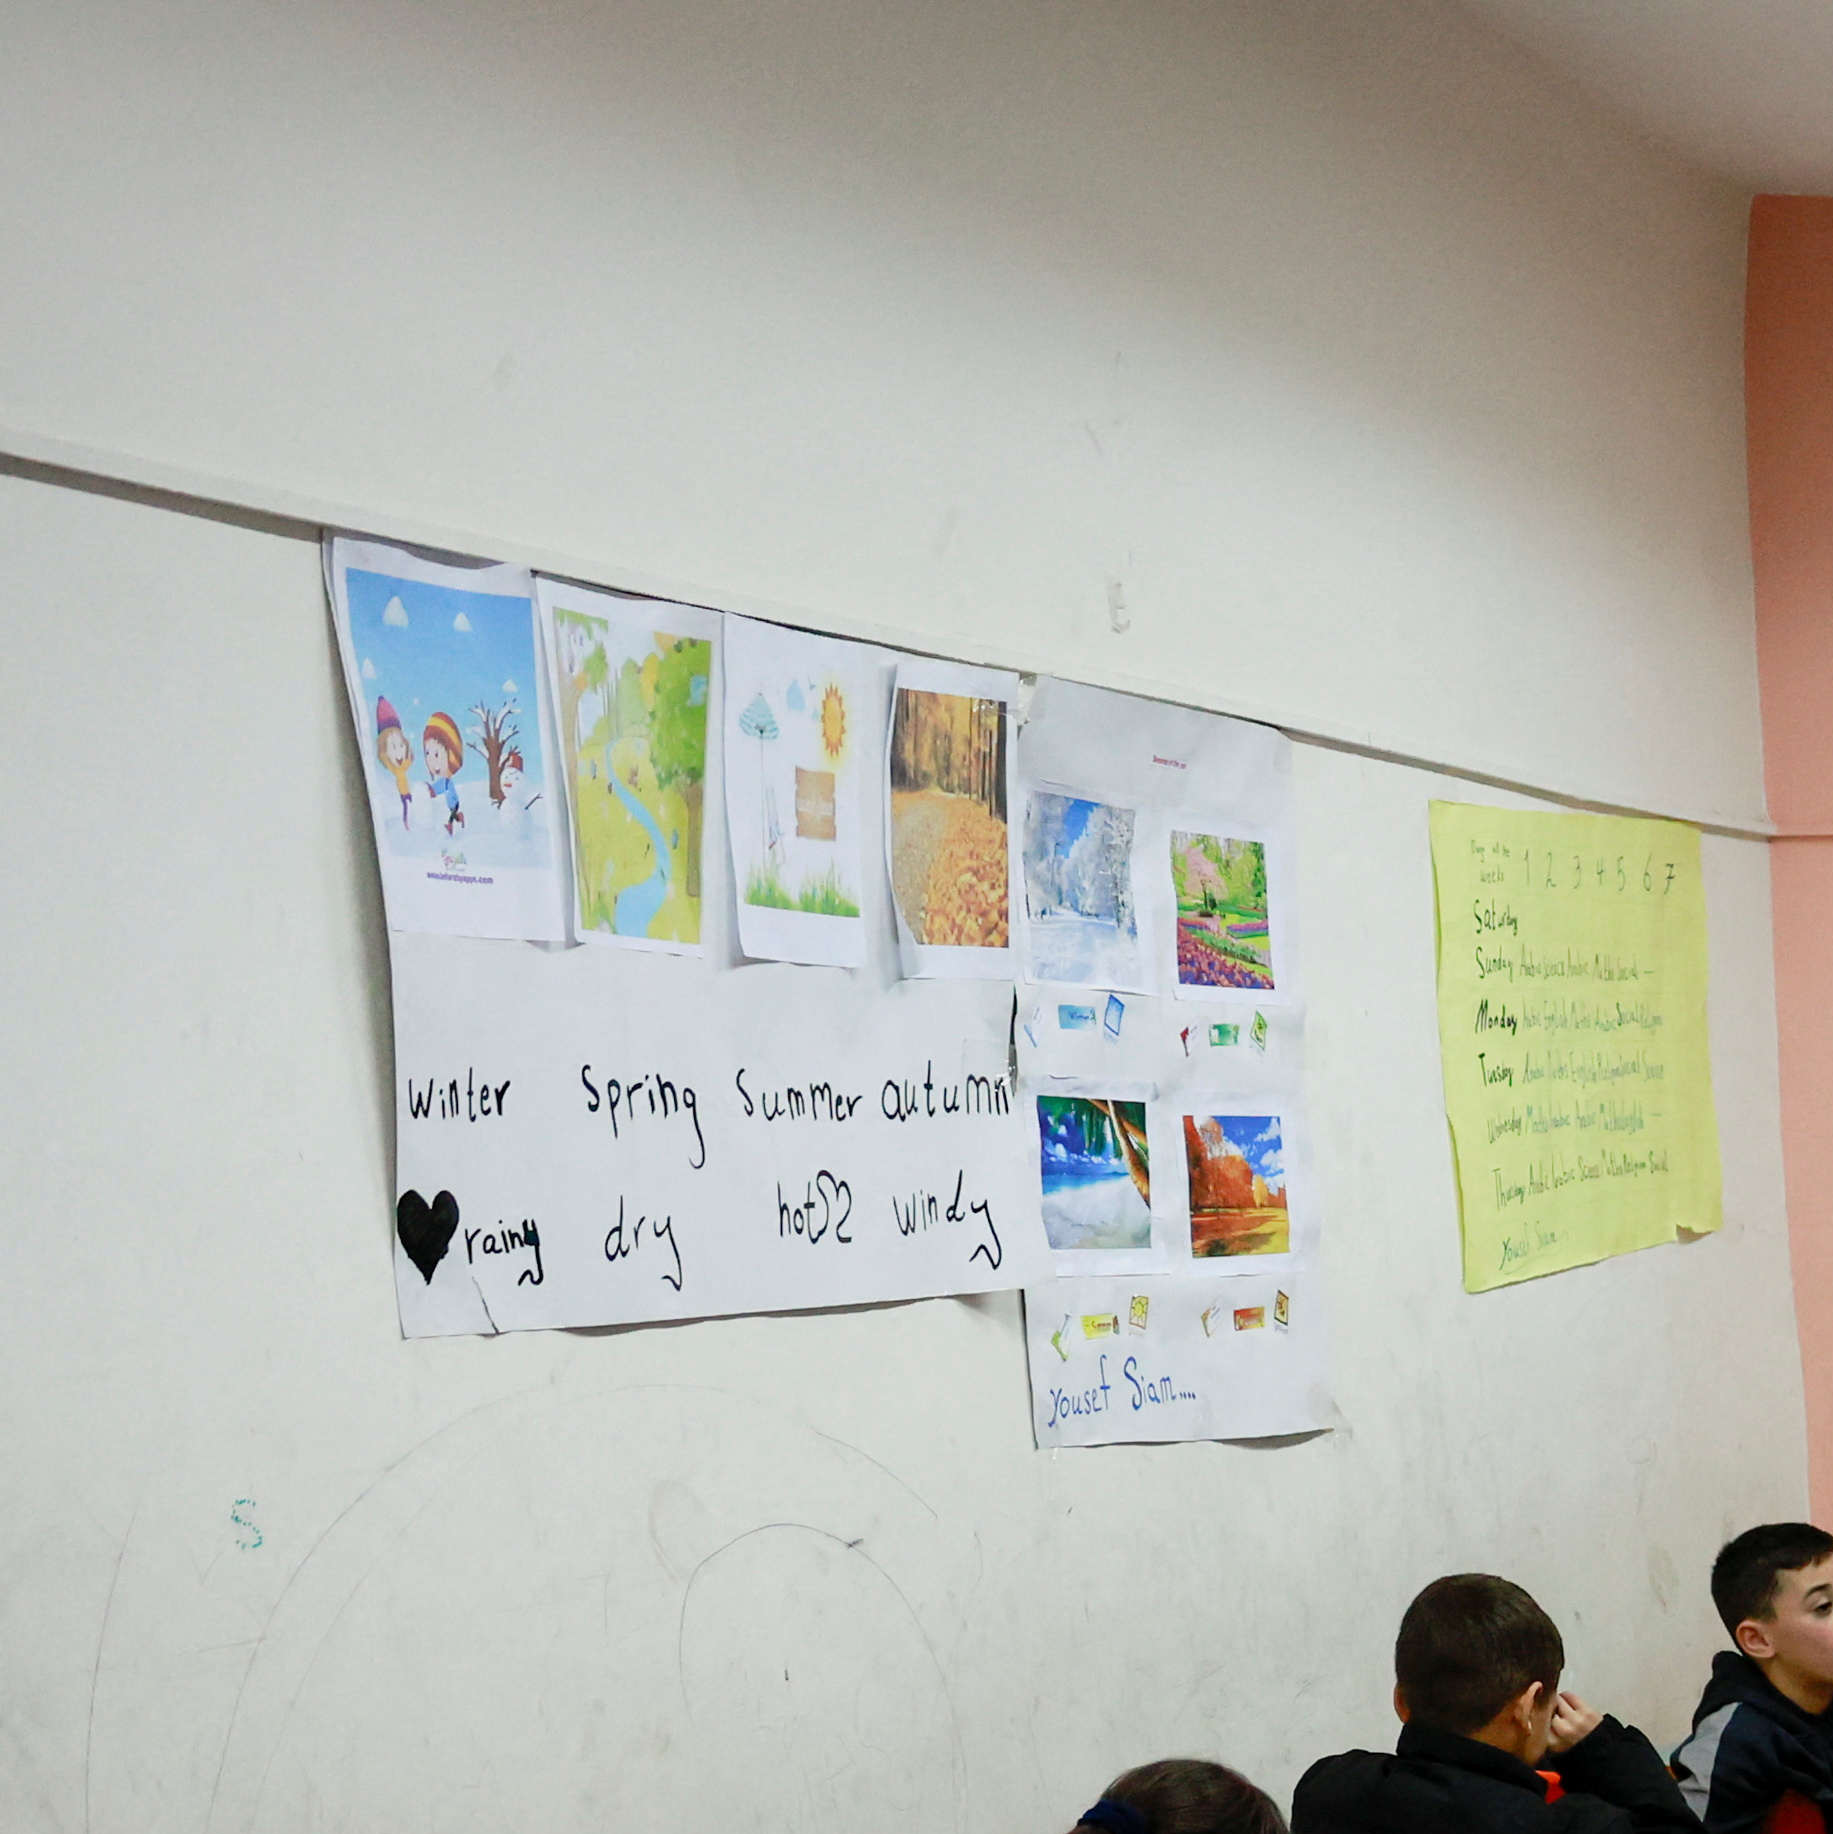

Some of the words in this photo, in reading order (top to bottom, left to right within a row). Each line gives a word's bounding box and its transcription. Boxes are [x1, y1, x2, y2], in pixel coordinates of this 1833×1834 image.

[1523, 849, 1531, 886] 1
[1545, 851, 1558, 890] 2
[1571, 855, 1583, 890] 3
[1595, 856, 1607, 886] 4
[1616, 855, 1627, 893] 5
[1643, 850, 1653, 892] 6
[1664, 862, 1677, 896] 7
[1475, 944, 1514, 983] Sunday
[1474, 999, 1518, 1037] Monday
[1478, 1051, 1514, 1087] Tuesday
[463, 1218, 545, 1286] rainy
[604, 1195, 682, 1291] dry
[892, 1168, 1002, 1271] windy
[231, 1498, 264, 1551] S
